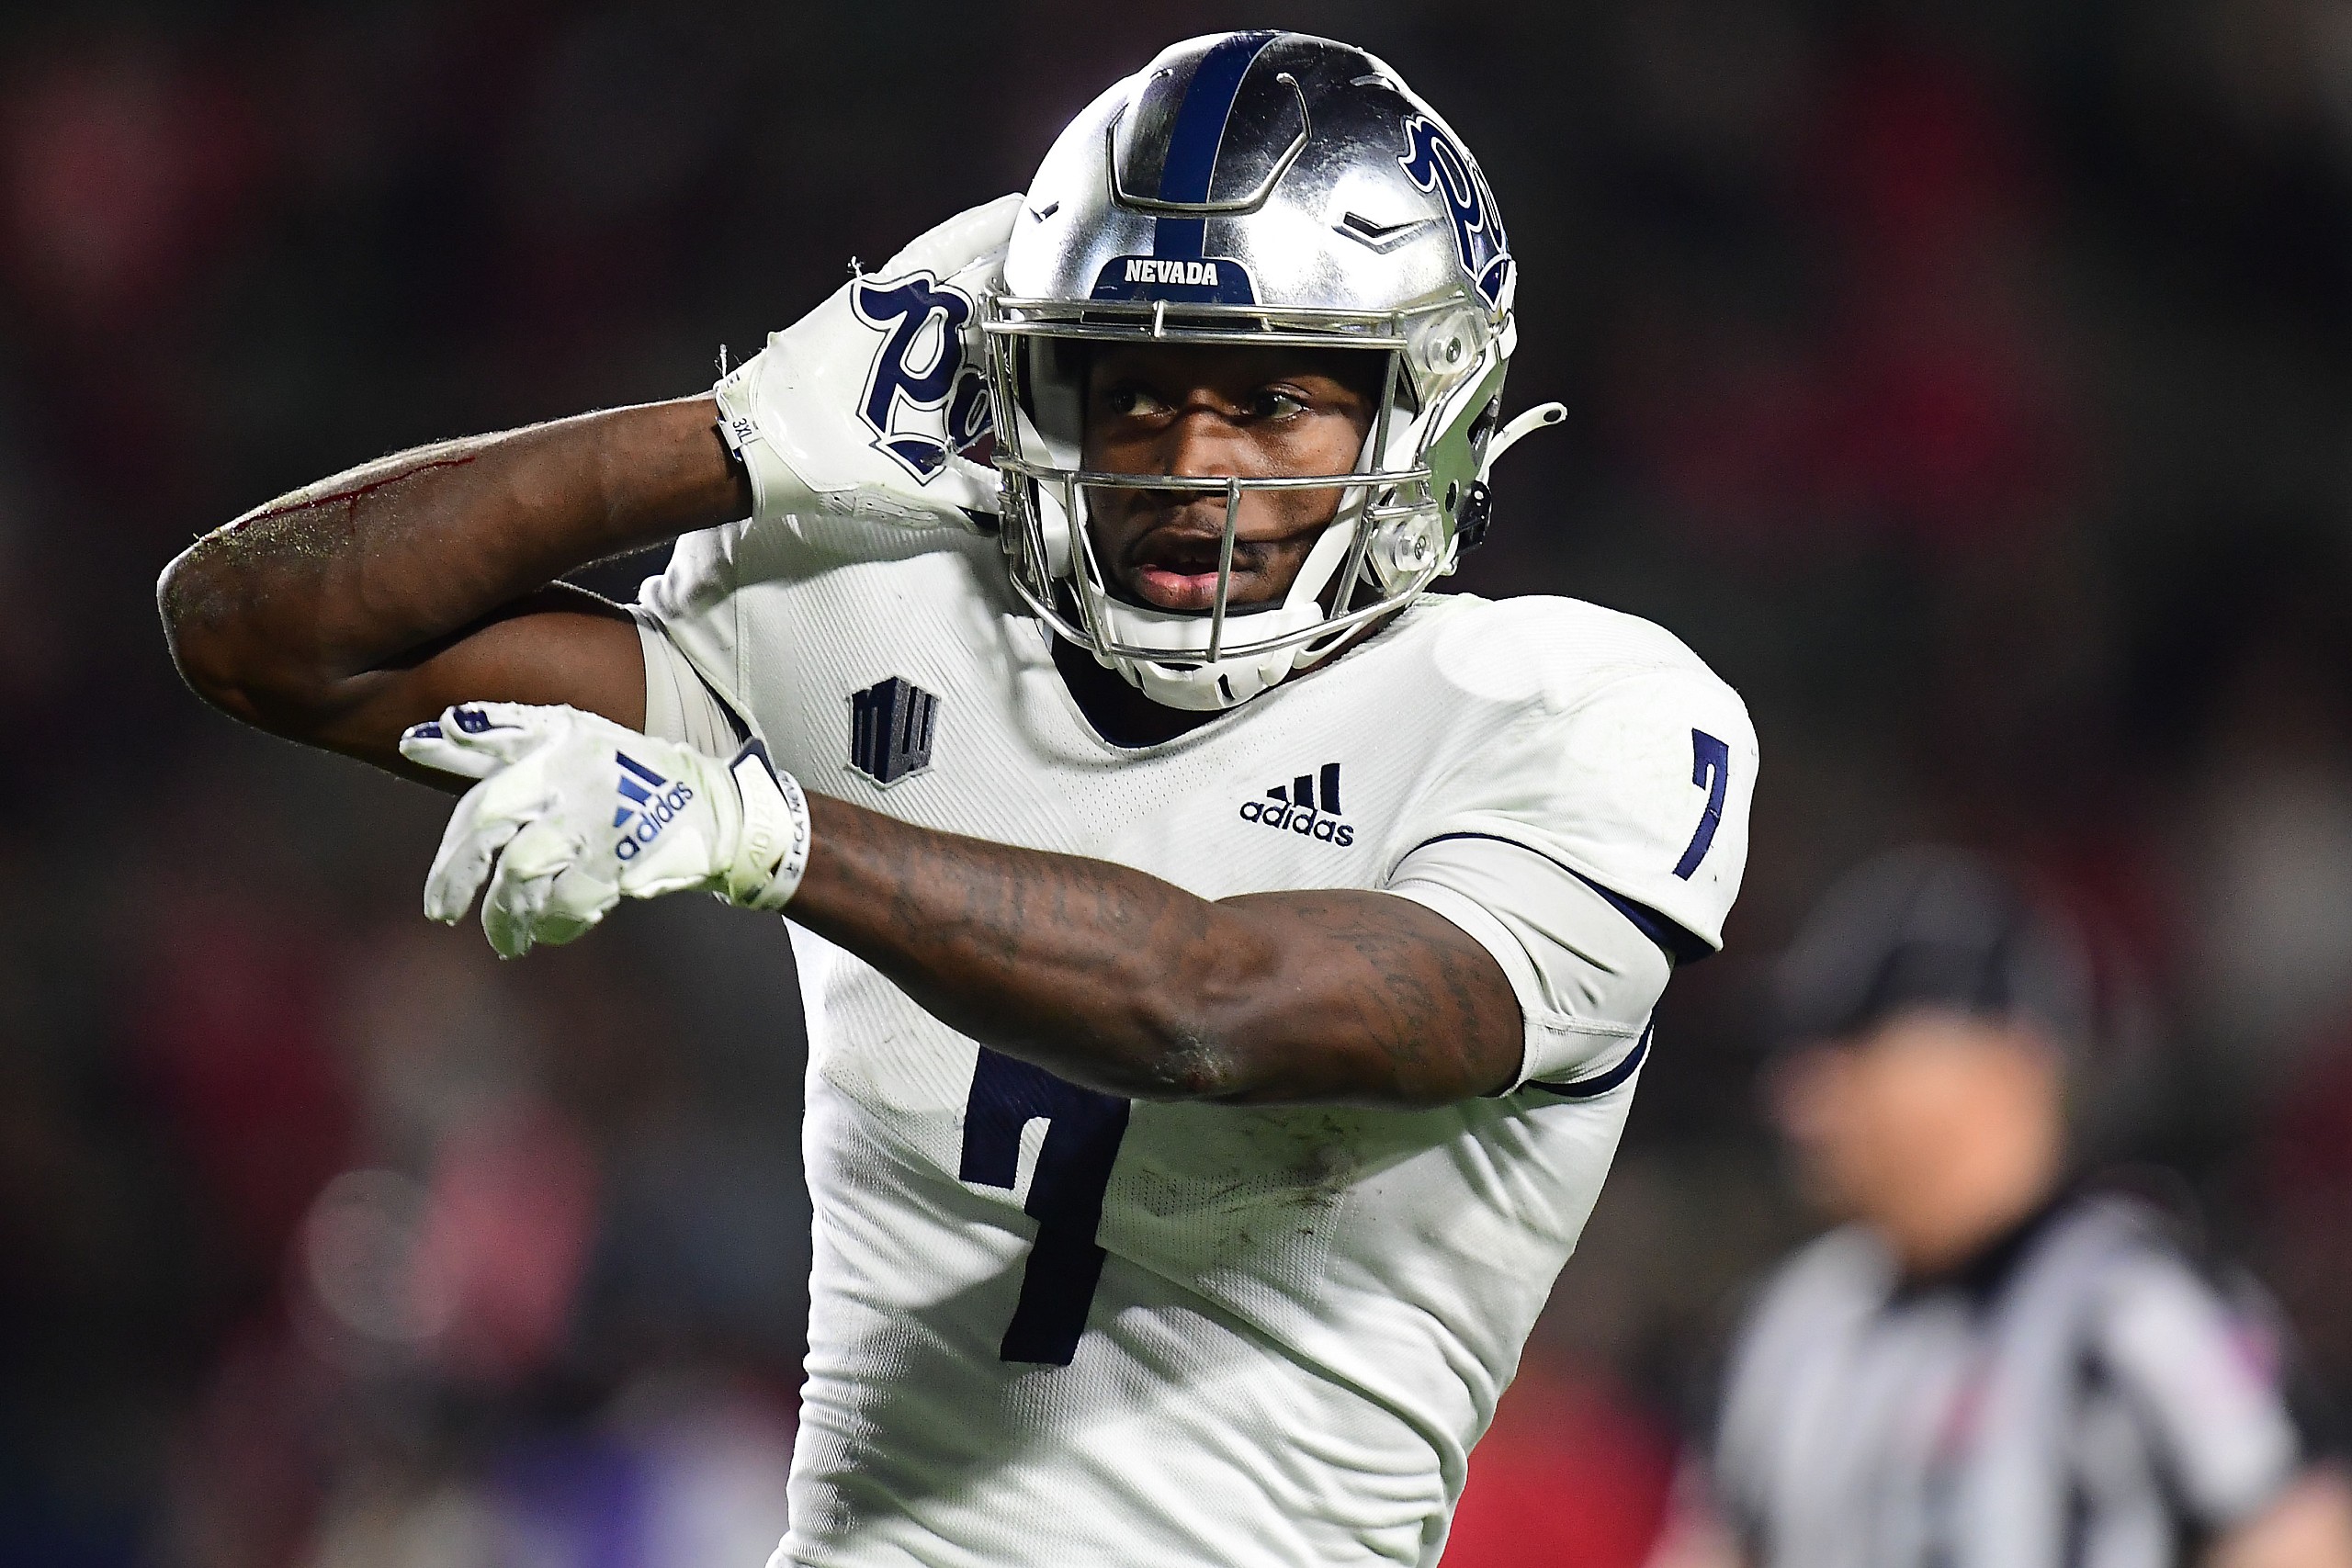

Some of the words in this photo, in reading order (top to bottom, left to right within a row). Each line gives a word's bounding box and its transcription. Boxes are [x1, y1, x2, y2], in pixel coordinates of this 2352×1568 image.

[1125, 259, 1219, 287] NEVADA
[732, 417, 752, 444] 3XL
[615, 781, 694, 861] adidas
[1239, 801, 1354, 847] adidas
[1672, 728, 1729, 881] 7
[959, 1043, 1132, 1366] 7
